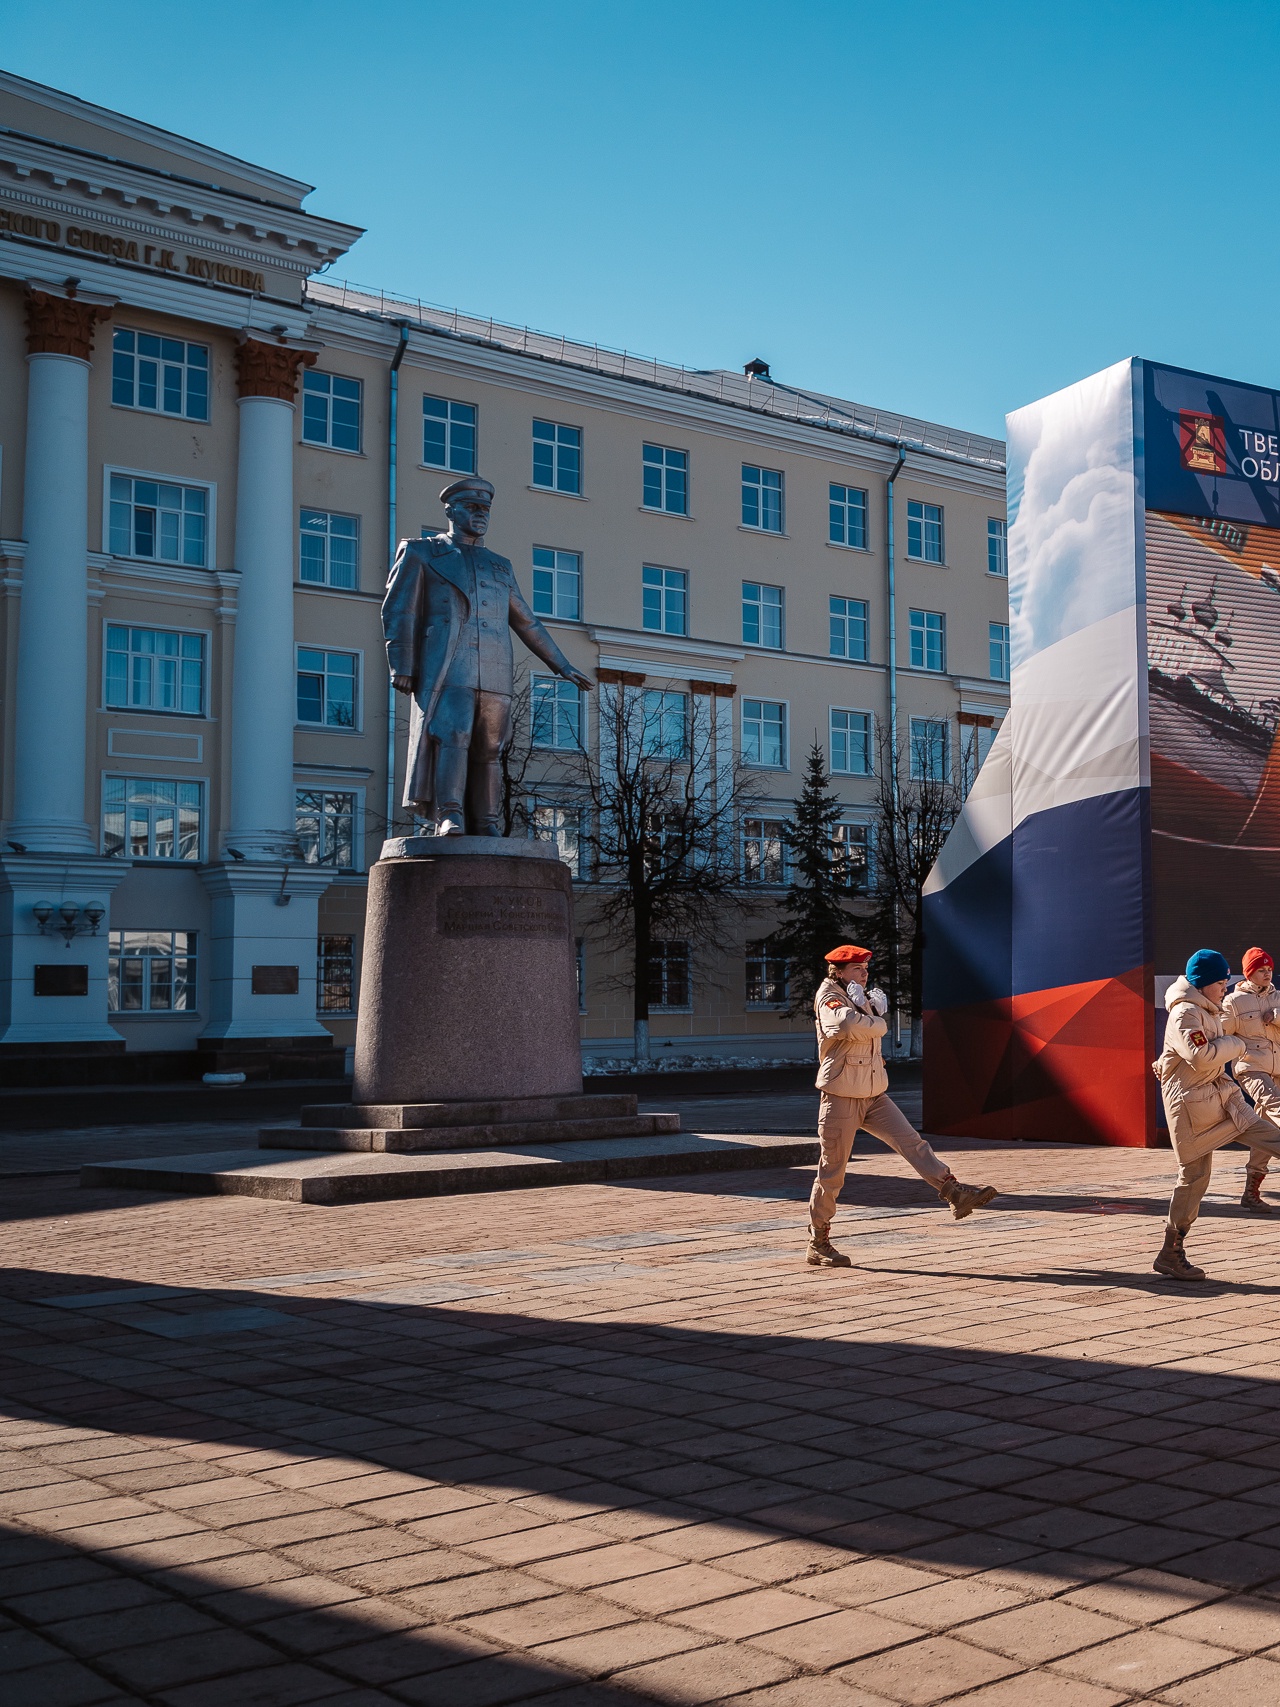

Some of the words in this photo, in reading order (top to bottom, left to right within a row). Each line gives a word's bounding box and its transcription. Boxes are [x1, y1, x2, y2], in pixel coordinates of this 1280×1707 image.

[67, 226, 139, 262] СОЮЗА
[186, 255, 265, 292] ЖУКОВА
[493, 895, 542, 907] ЖУКОВ
